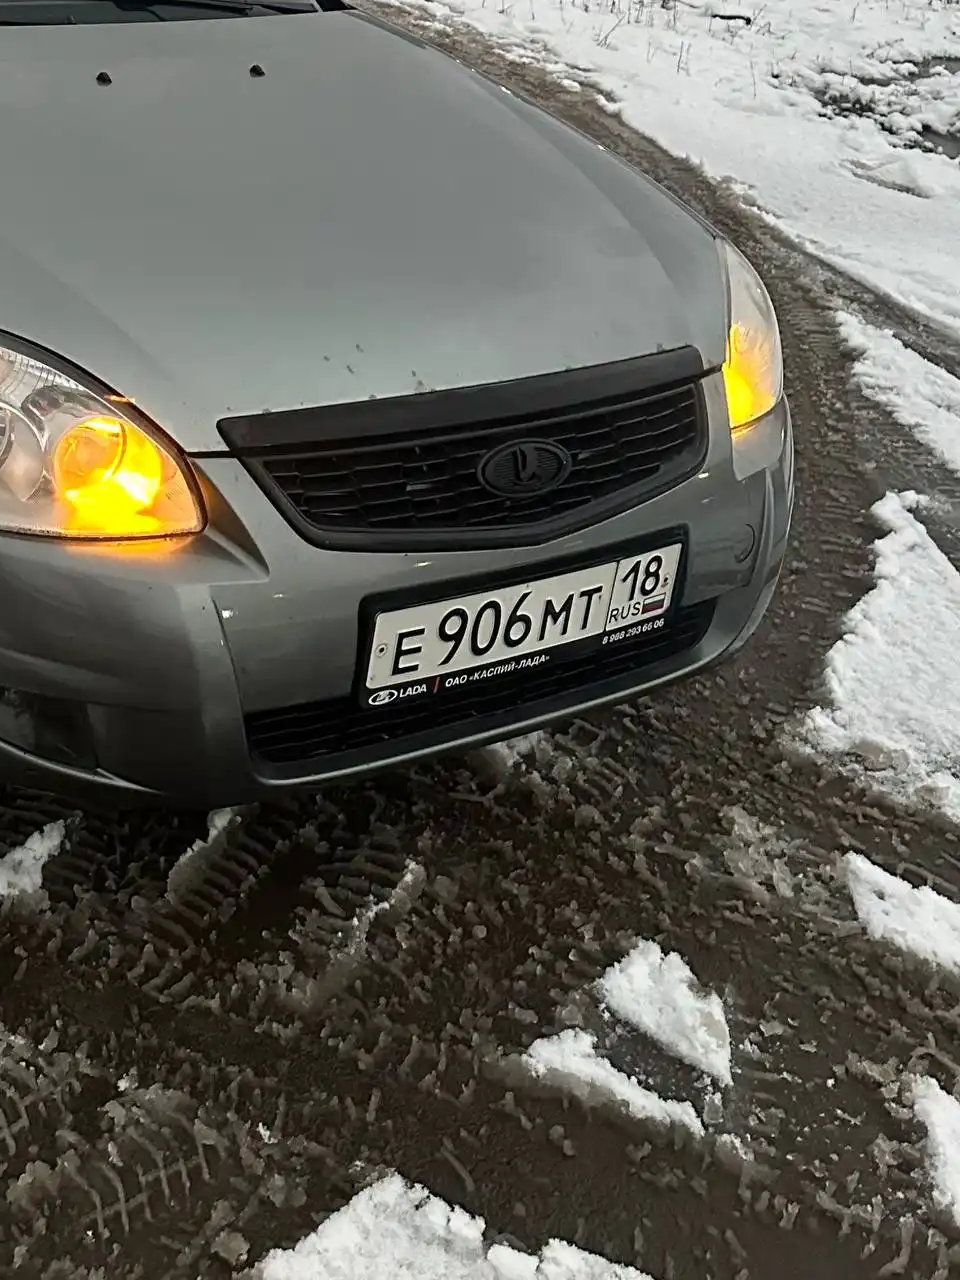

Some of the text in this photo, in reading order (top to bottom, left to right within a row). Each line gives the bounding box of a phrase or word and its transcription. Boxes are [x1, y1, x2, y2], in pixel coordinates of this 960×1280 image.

[622, 555, 663, 601] 18
[609, 601, 641, 624] RUS
[399, 683, 427, 698] LADA
[445, 674, 468, 688] ОАО
